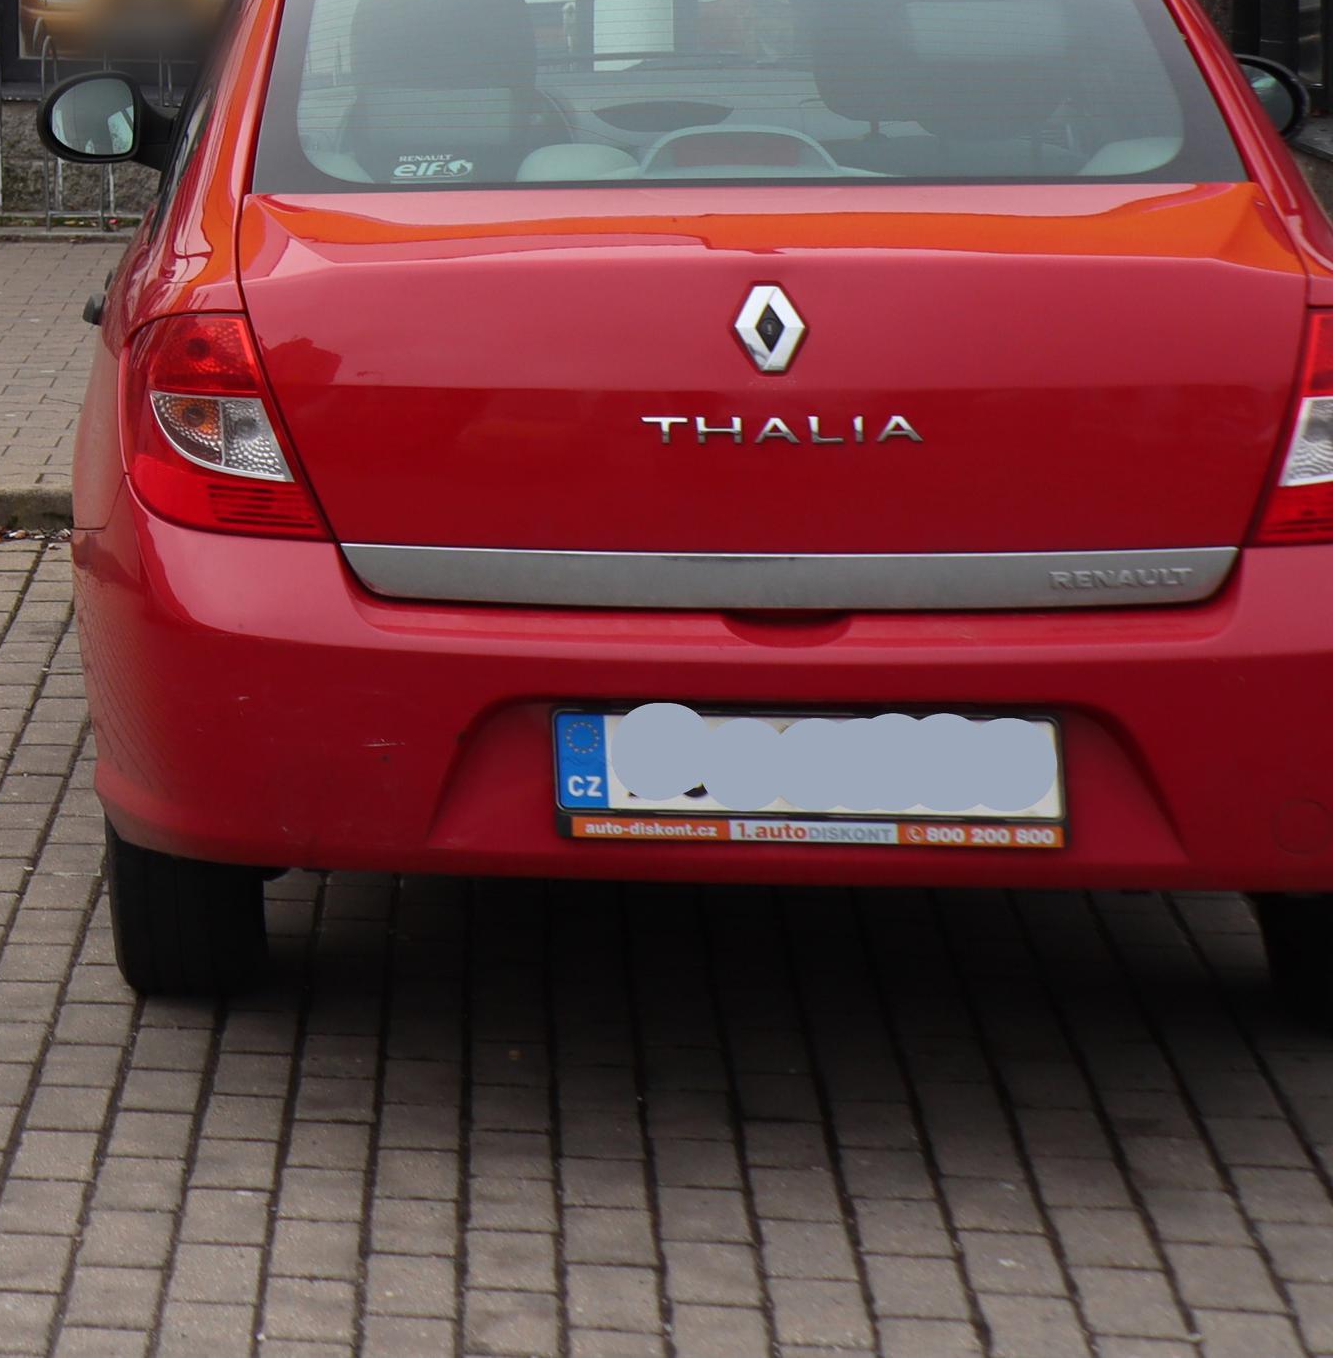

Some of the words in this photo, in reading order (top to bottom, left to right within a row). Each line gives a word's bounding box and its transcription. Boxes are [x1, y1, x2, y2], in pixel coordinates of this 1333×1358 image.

[399, 154, 453, 162] RENAULT
[640, 415, 924, 444] THALIA
[1048, 568, 1193, 590] RENAULT
[567, 775, 603, 798] CZ
[585, 820, 718, 839] auto-diskont.cz
[926, 826, 964, 843] 800
[972, 827, 1009, 844] 200
[1016, 827, 1054, 845] 800
